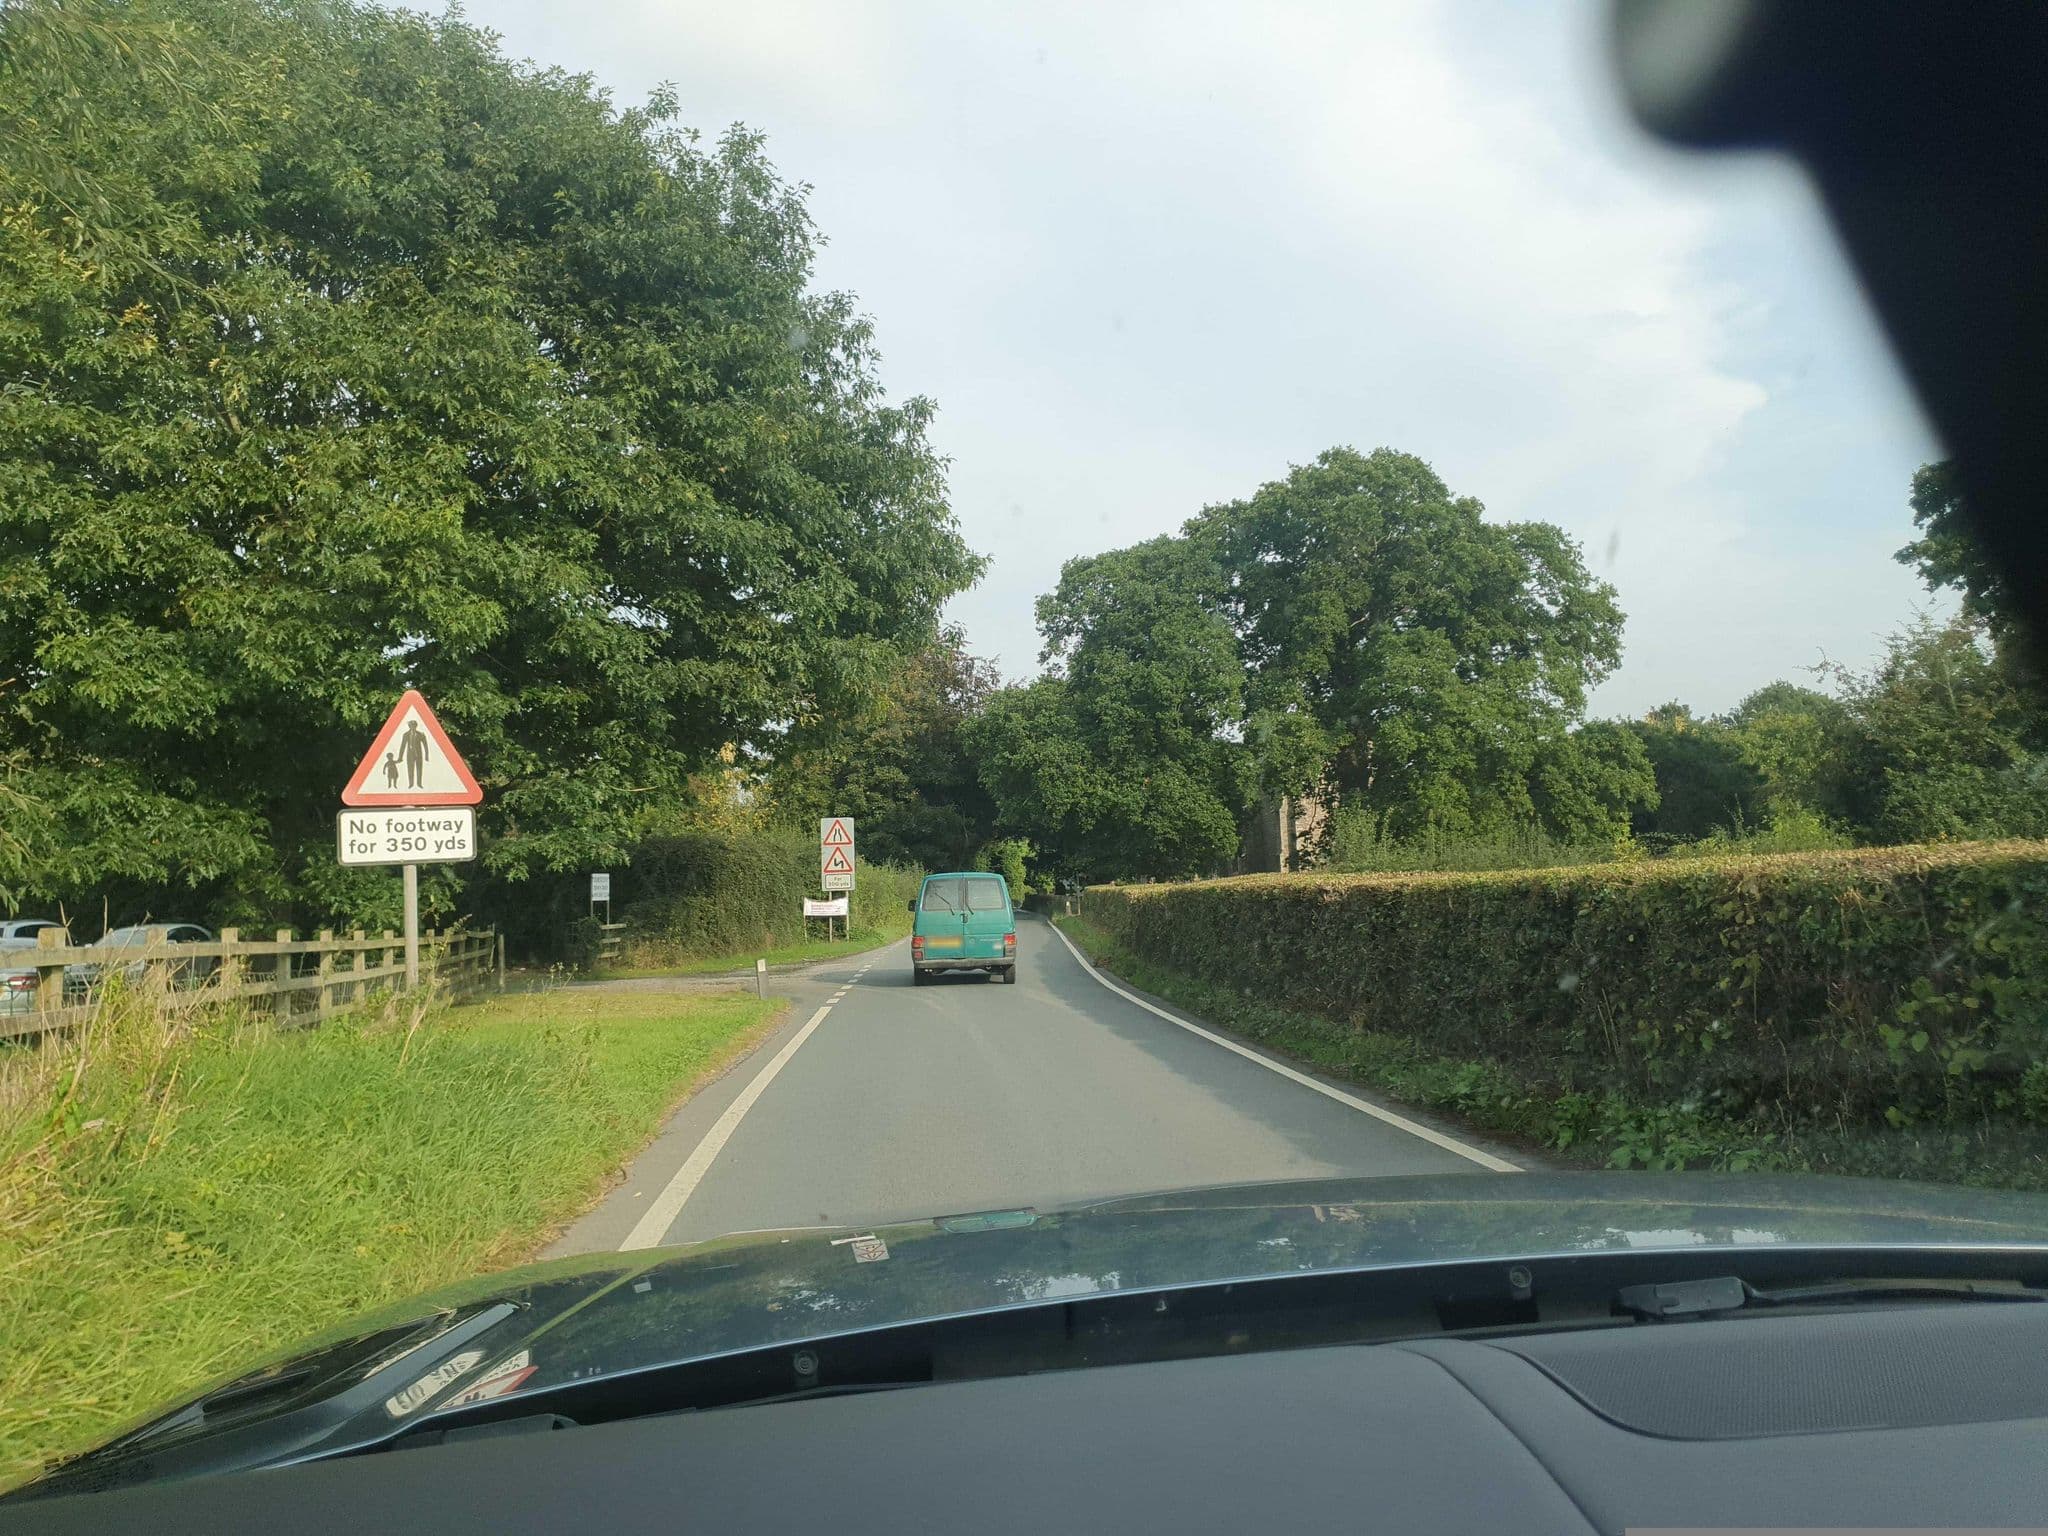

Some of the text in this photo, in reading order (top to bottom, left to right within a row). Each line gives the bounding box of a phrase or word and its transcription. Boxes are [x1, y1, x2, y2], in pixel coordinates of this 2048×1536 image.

[349, 818, 464, 834] No footway
[348, 836, 466, 854] for 350 yds
